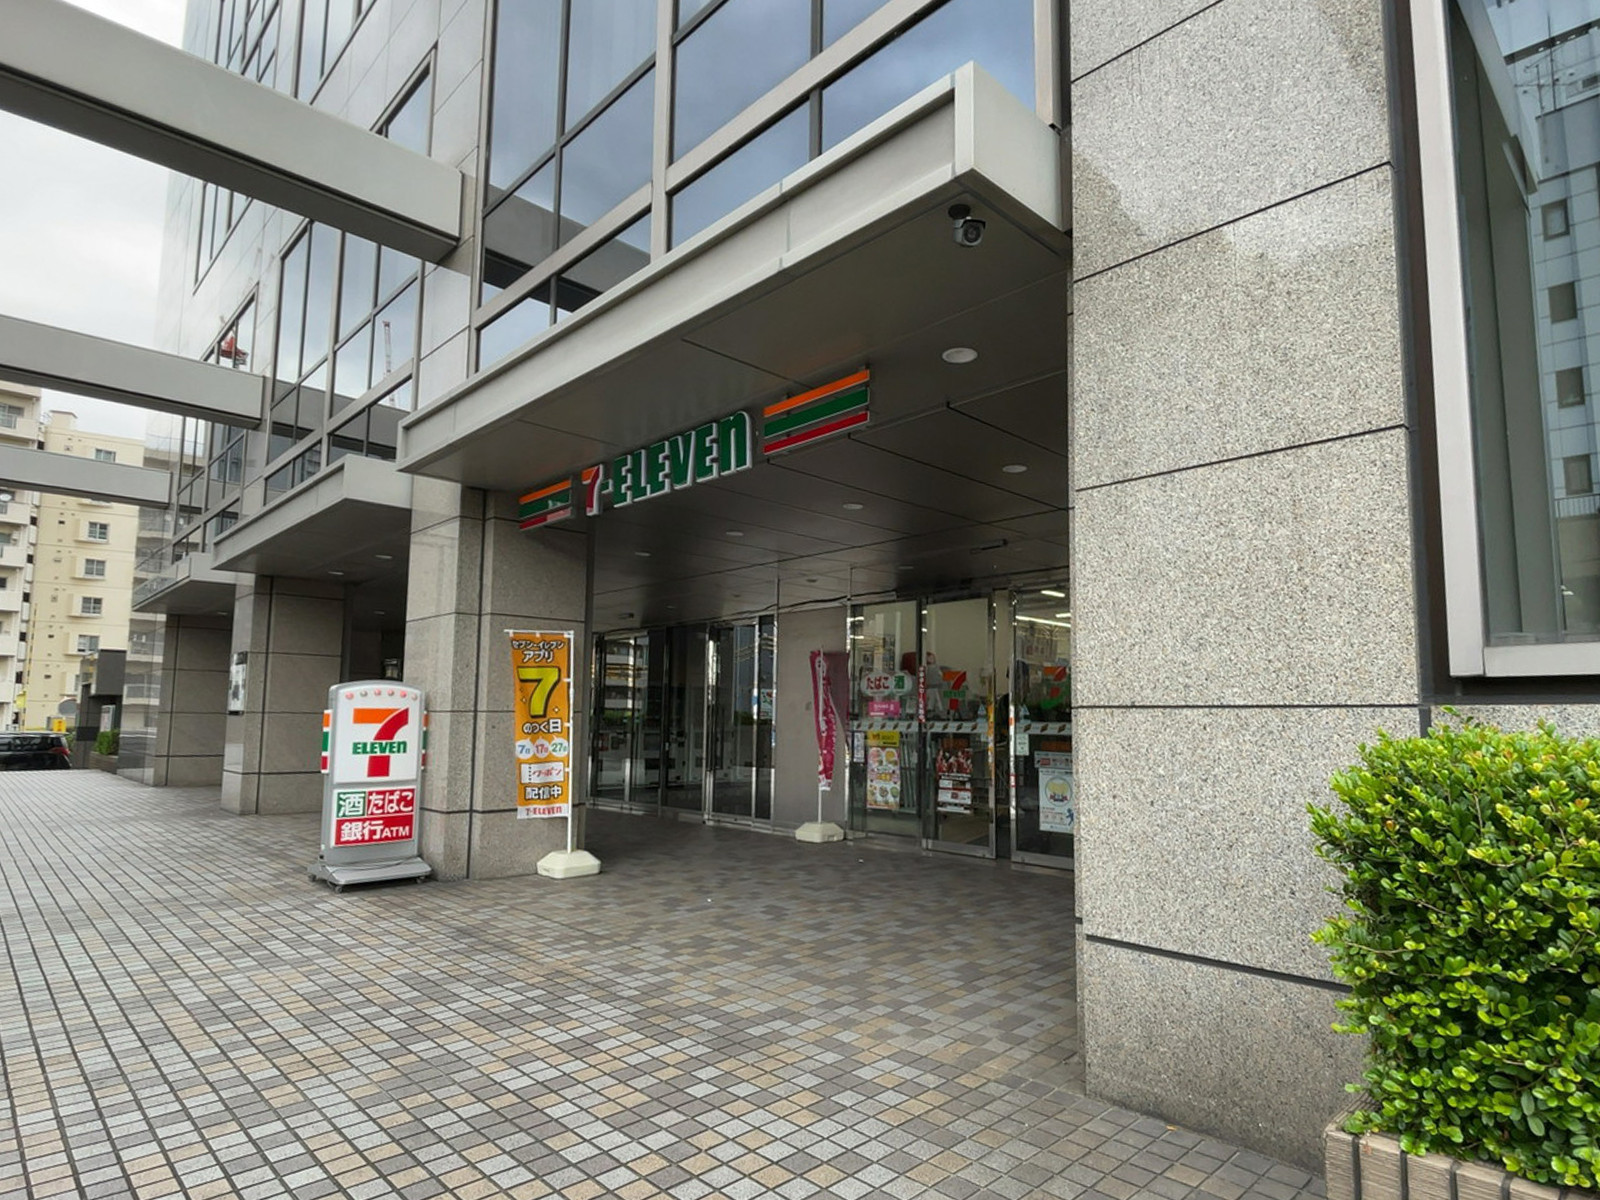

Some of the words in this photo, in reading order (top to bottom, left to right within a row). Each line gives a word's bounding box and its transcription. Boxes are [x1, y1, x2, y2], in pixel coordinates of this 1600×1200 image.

[522, 650, 554, 663] アプリ
[867, 675, 890, 690] たばこ
[894, 675, 905, 689] 酒
[517, 666, 561, 718] 7
[522, 718, 562, 734] のつく日
[352, 707, 409, 777] 7
[532, 767, 562, 778] クーポン
[524, 785, 562, 800] 配信中
[338, 793, 364, 818] 酒
[367, 791, 413, 815] たばこ
[340, 820, 410, 842] 銀行ATM
